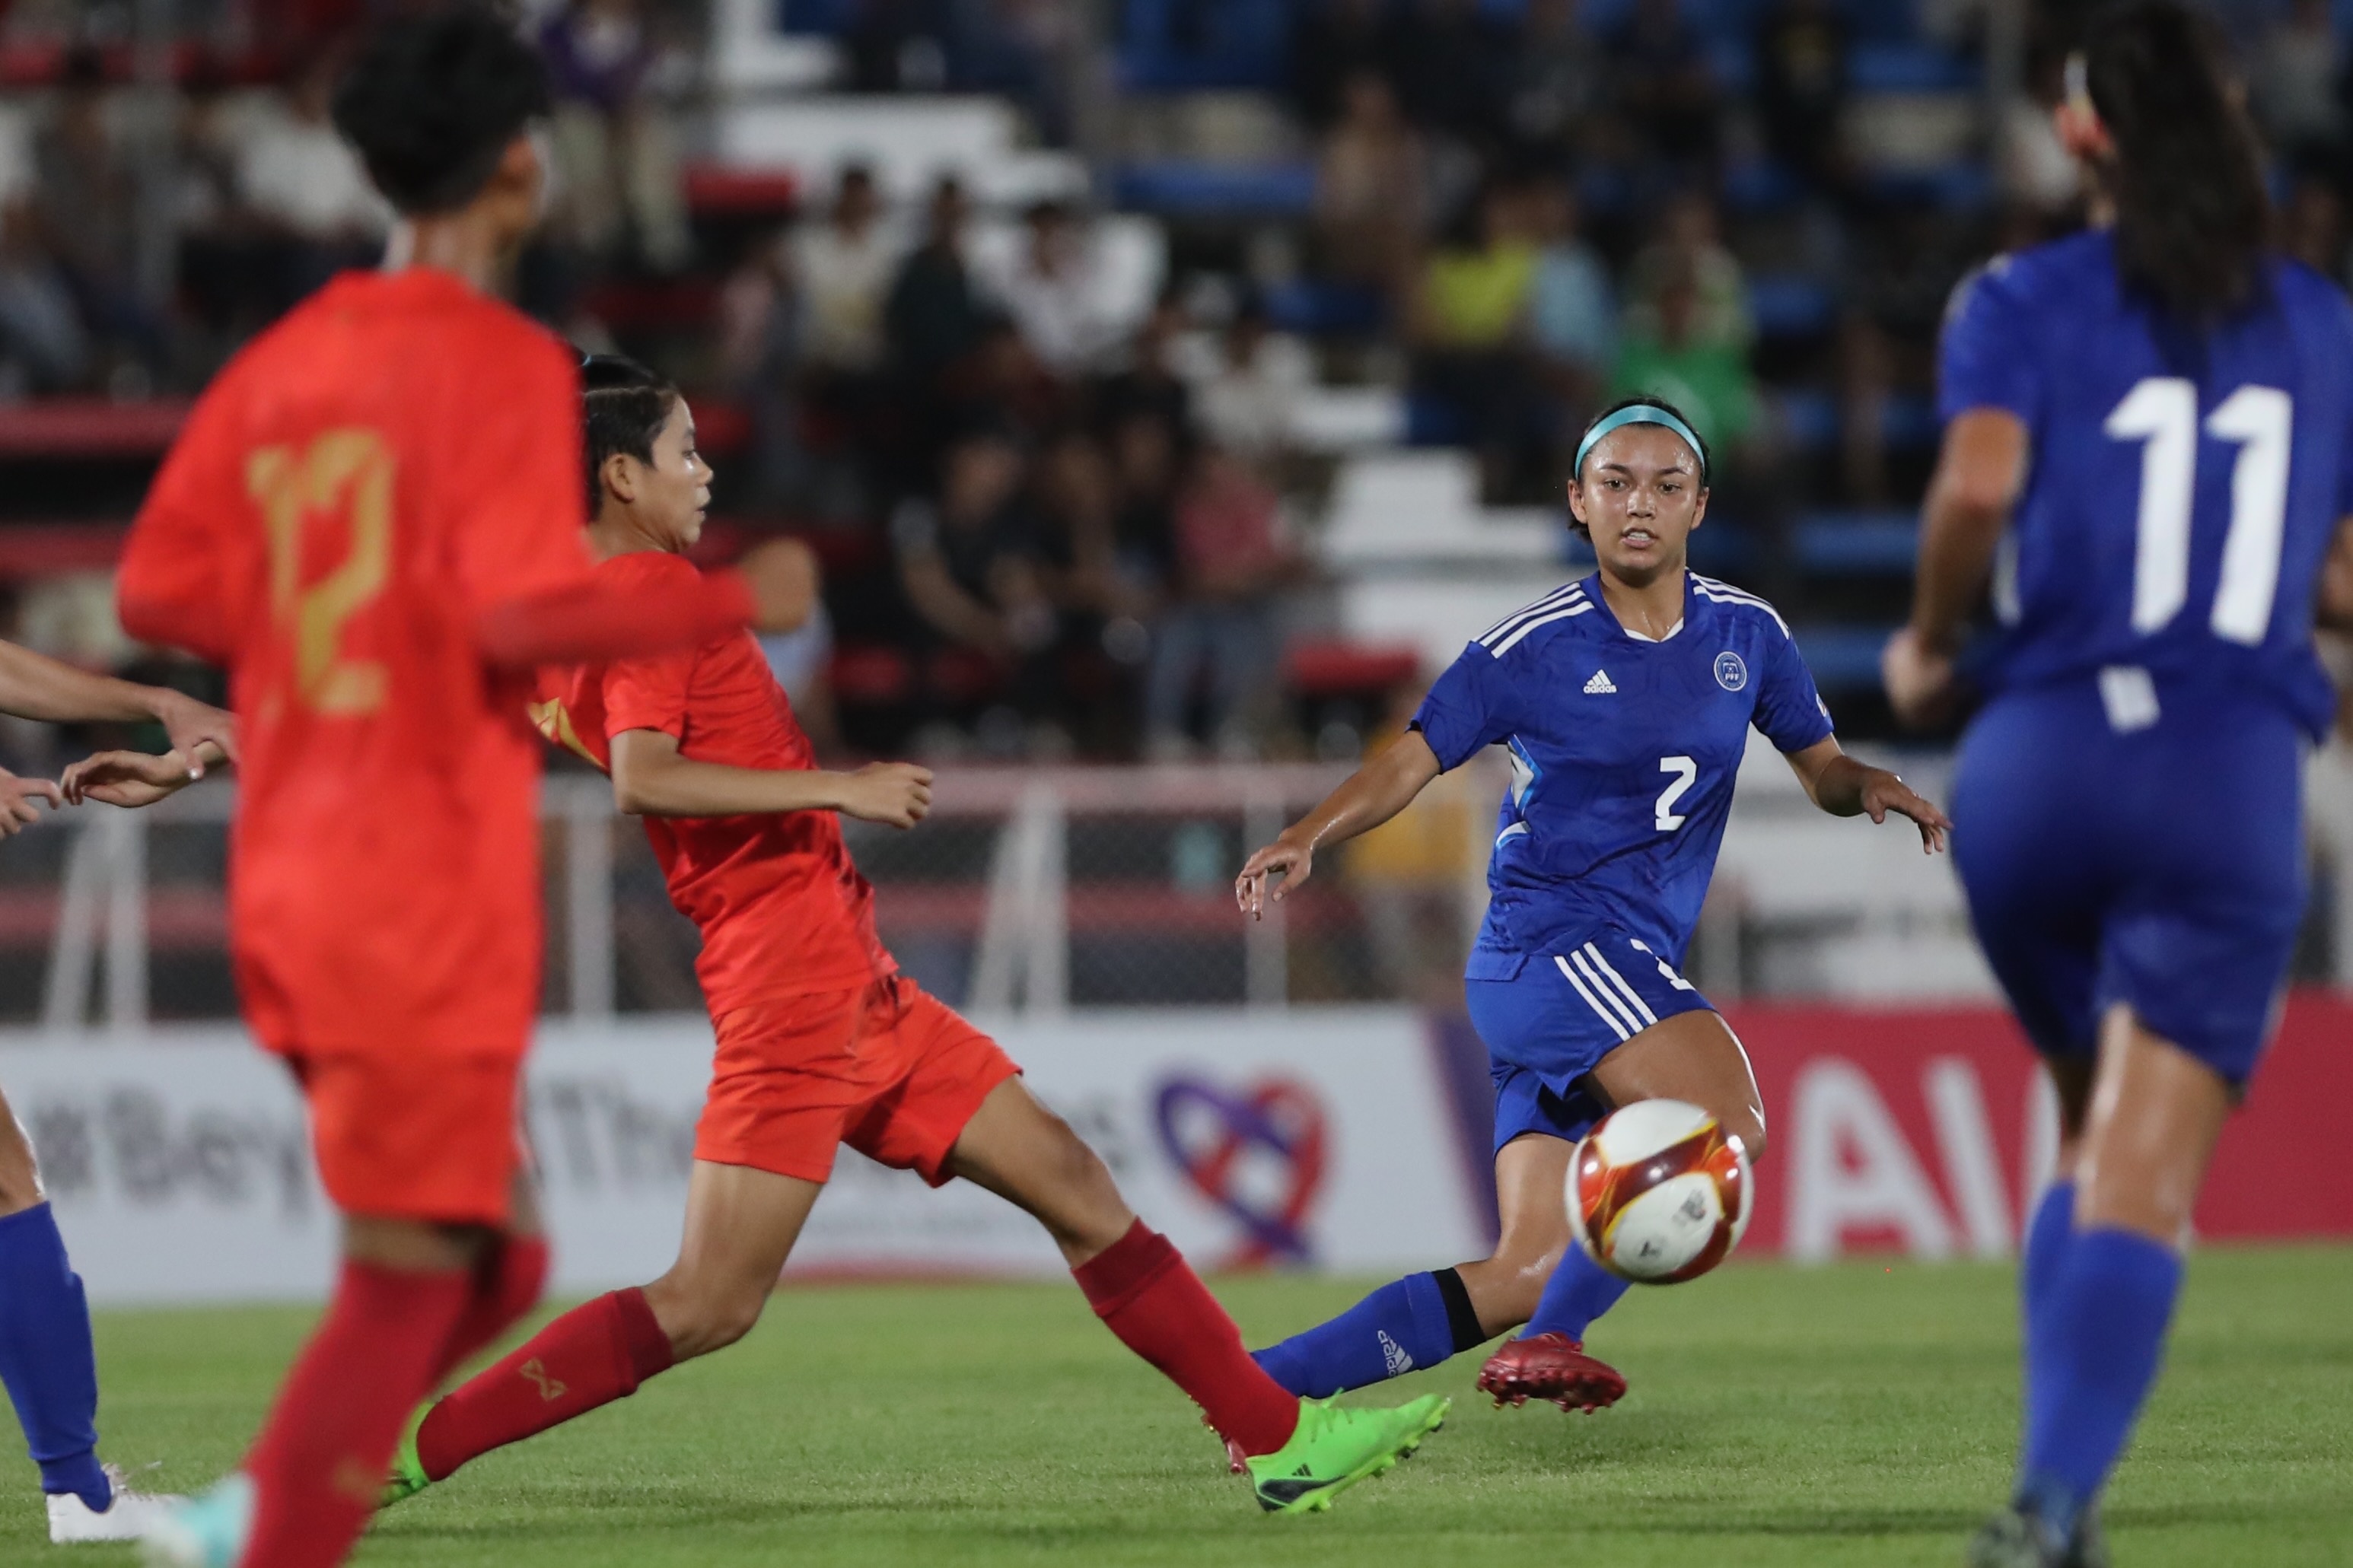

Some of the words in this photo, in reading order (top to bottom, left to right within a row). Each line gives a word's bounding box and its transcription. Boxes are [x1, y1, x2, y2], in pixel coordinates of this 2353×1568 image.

[2103, 377, 2294, 648] 11
[245, 428, 394, 717] 12
[1584, 685, 1617, 694] adidas
[1654, 755, 1697, 832] 2
[1377, 1329, 1398, 1377] adida
